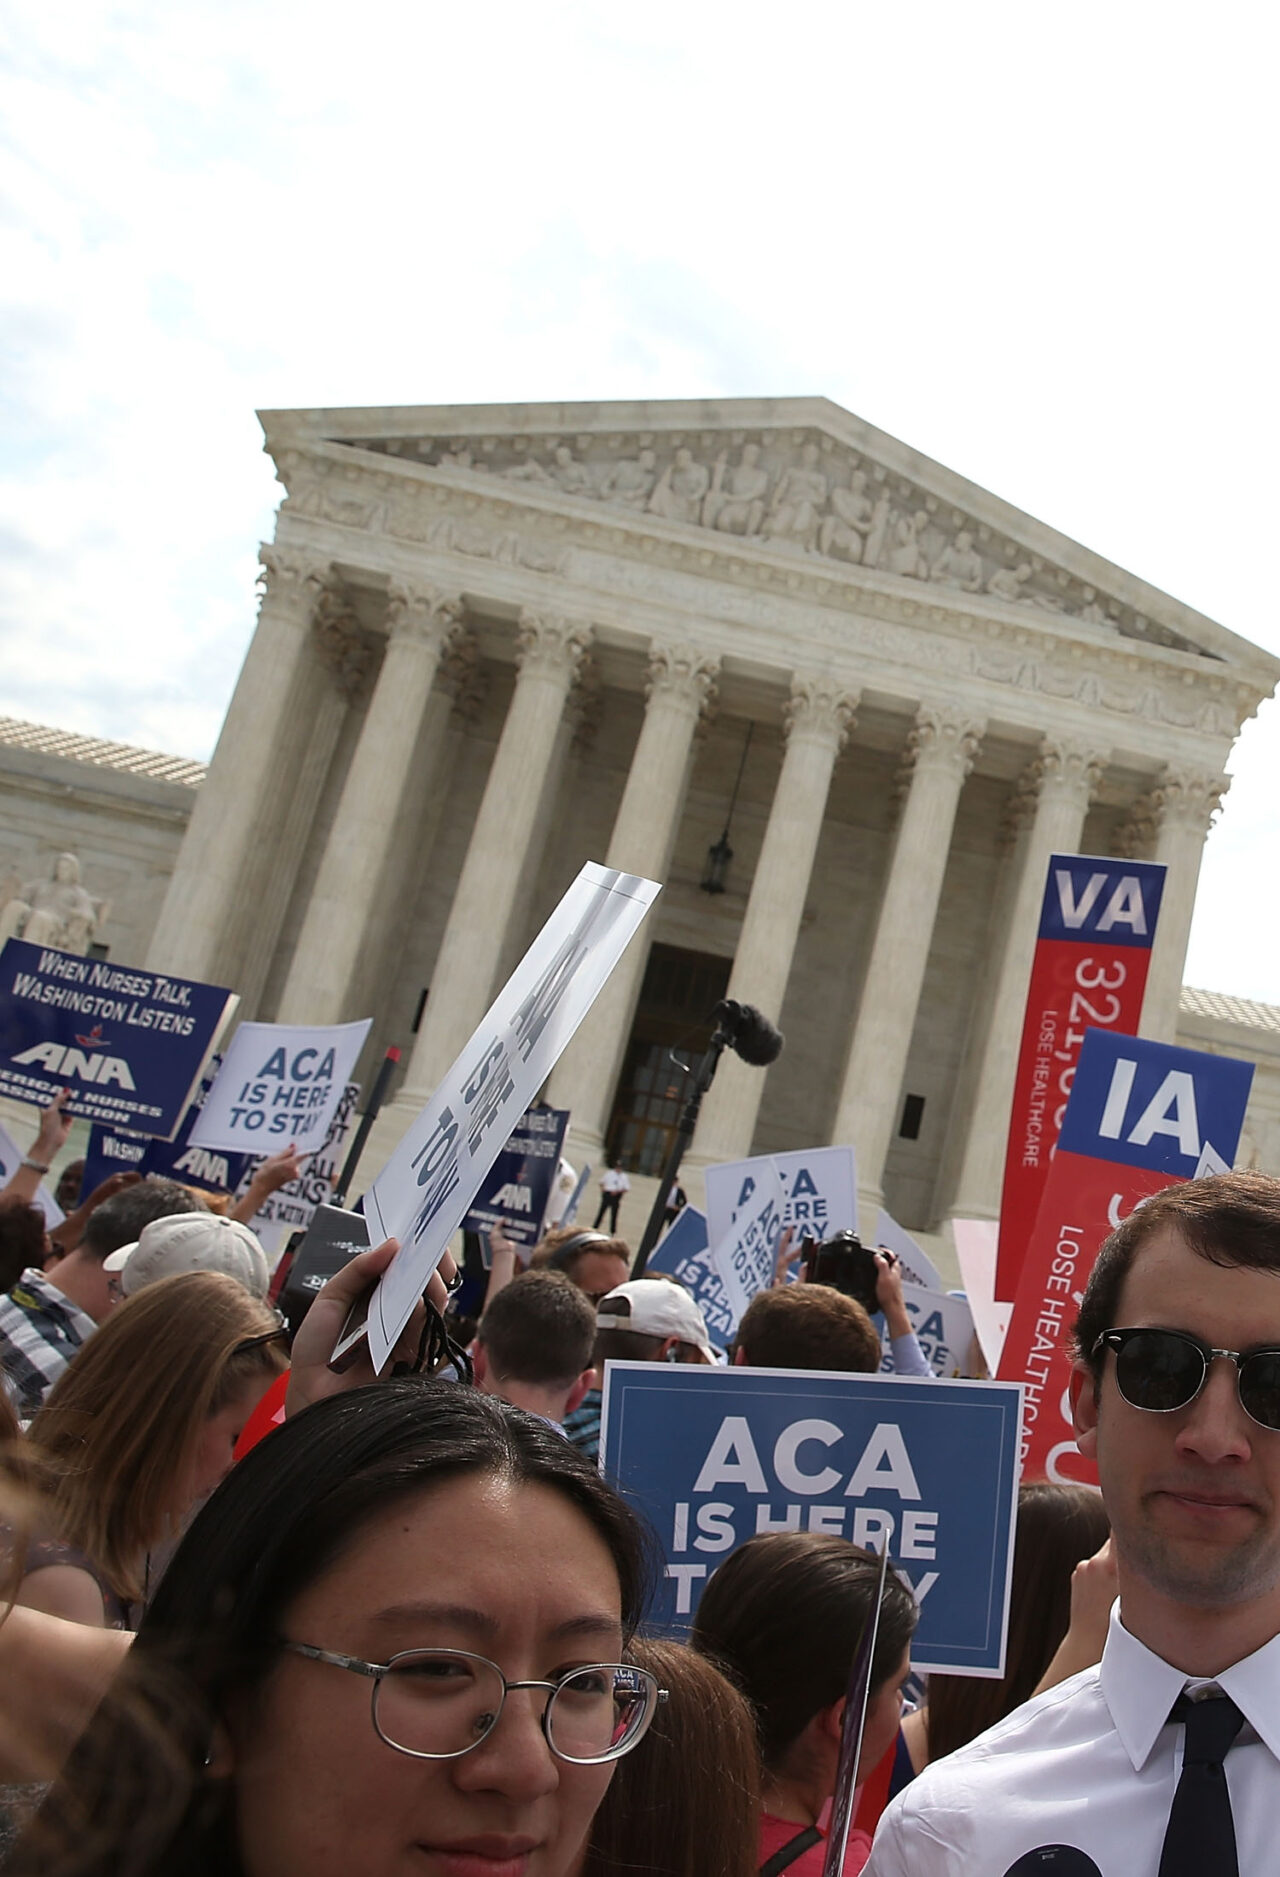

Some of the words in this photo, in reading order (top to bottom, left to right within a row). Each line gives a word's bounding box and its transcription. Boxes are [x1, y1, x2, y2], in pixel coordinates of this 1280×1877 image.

[1055, 869, 1148, 936] VA
[12, 973, 128, 1022] WASHINGTON
[127, 1002, 196, 1036] LISTENS
[38, 951, 90, 983] WHEN
[88, 963, 152, 998] NURSES
[152, 978, 191, 1008] TALK,
[1036, 1010, 1058, 1053] LOSE
[10, 1041, 137, 1091] ANA
[256, 1047, 336, 1082] ACA
[84, 1092, 163, 1118] NURSES
[238, 1082, 268, 1104] IS
[272, 1085, 333, 1108] HERE
[1022, 1056, 1050, 1168] HEALTHCARE
[1098, 1057, 1202, 1157] IA
[229, 1108, 266, 1130] TO
[268, 1111, 324, 1136] STAY
[173, 1147, 228, 1187] ANA
[674, 1258, 702, 1285] IS
[1046, 1224, 1084, 1294] LOSE
[692, 1416, 921, 1500] ACA
[672, 1501, 736, 1554] IS
[756, 1503, 939, 1560] HERE
[663, 1563, 717, 1614] T
